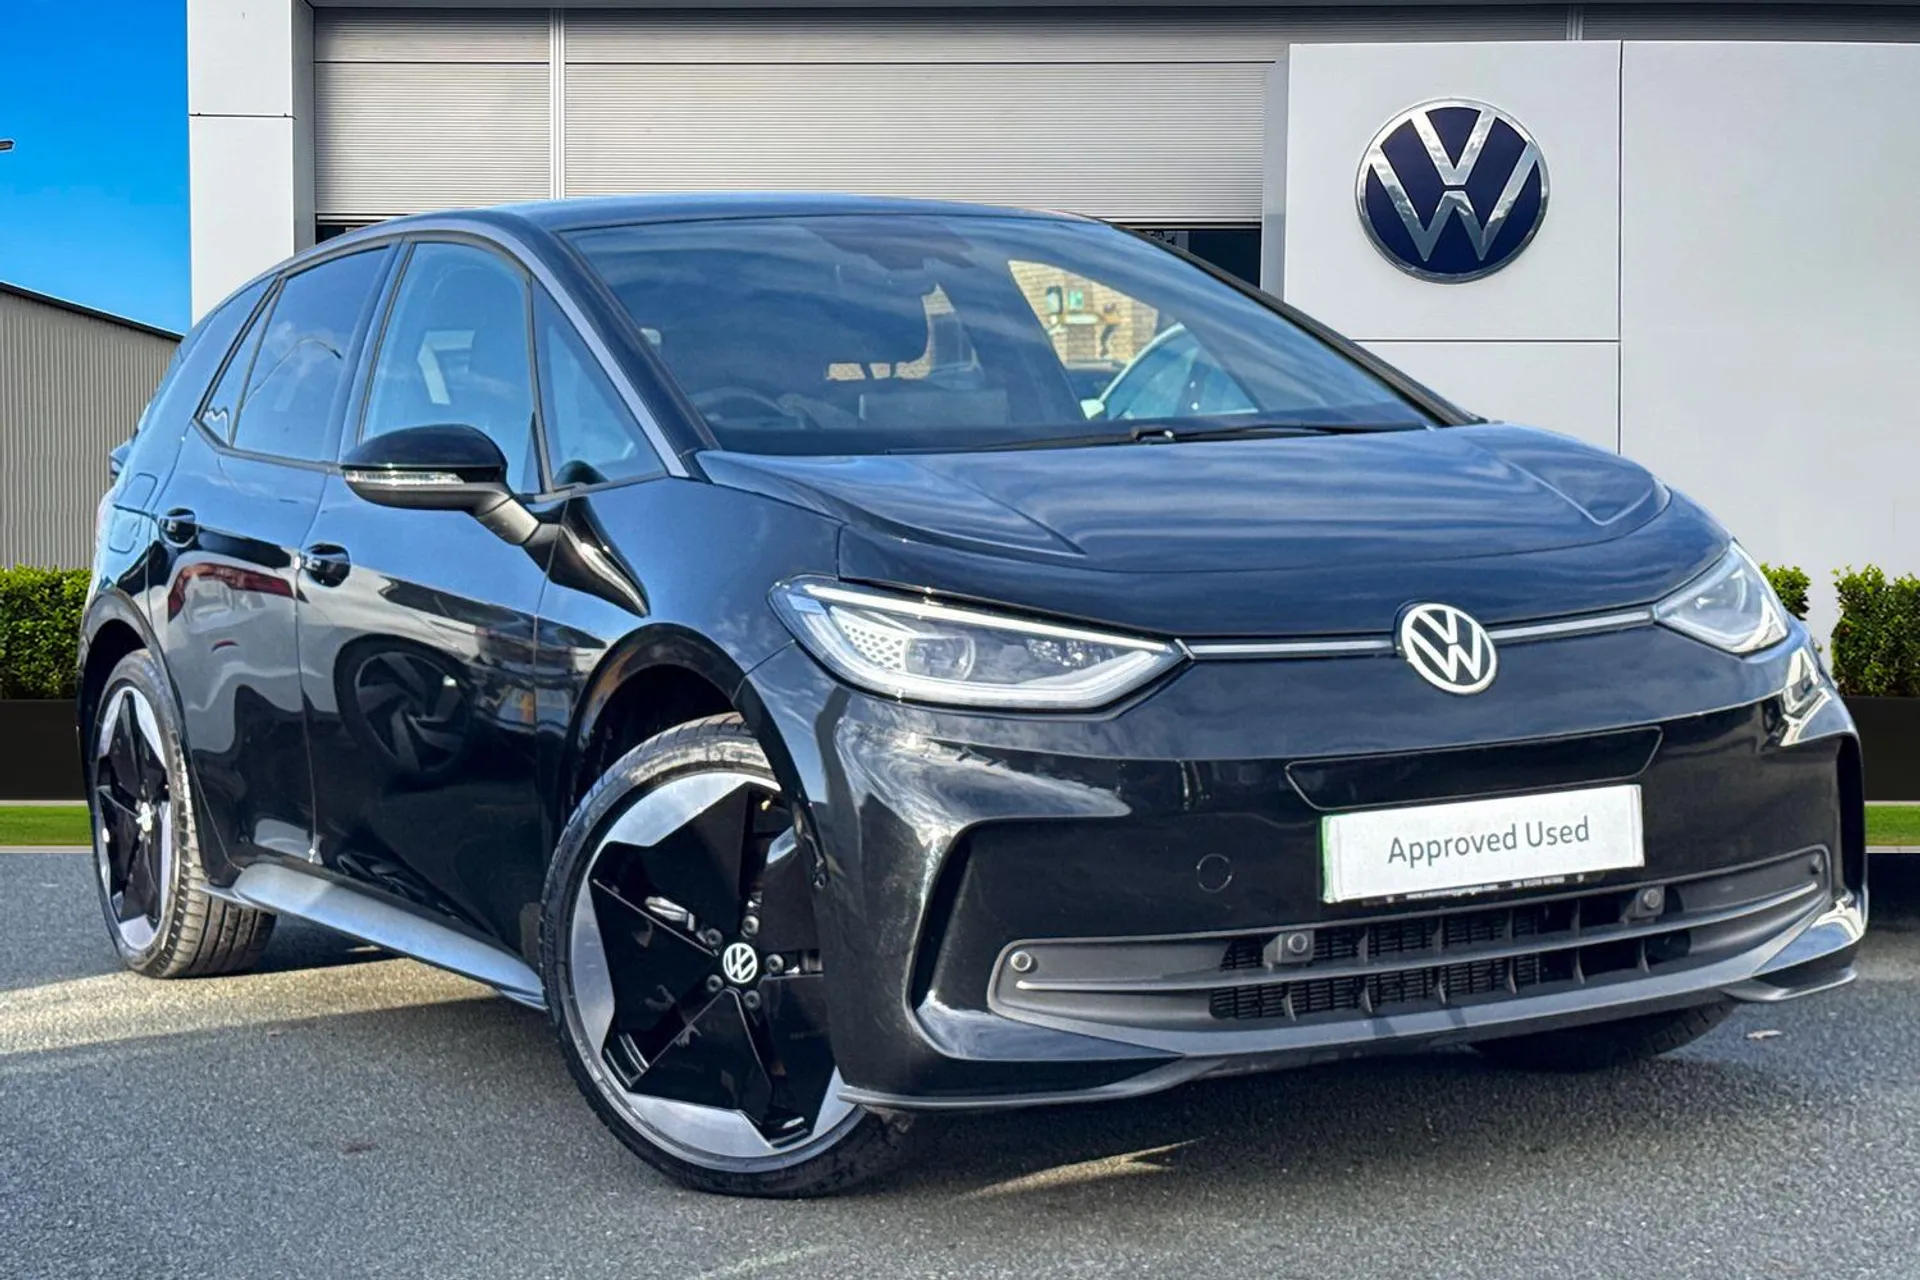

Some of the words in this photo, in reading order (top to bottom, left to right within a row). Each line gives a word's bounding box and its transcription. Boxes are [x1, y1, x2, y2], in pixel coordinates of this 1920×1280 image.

[1364, 102, 1544, 272] VW
[1405, 606, 1489, 687] VW
[1387, 823, 1518, 869] Approved
[1525, 815, 1590, 848] Used
